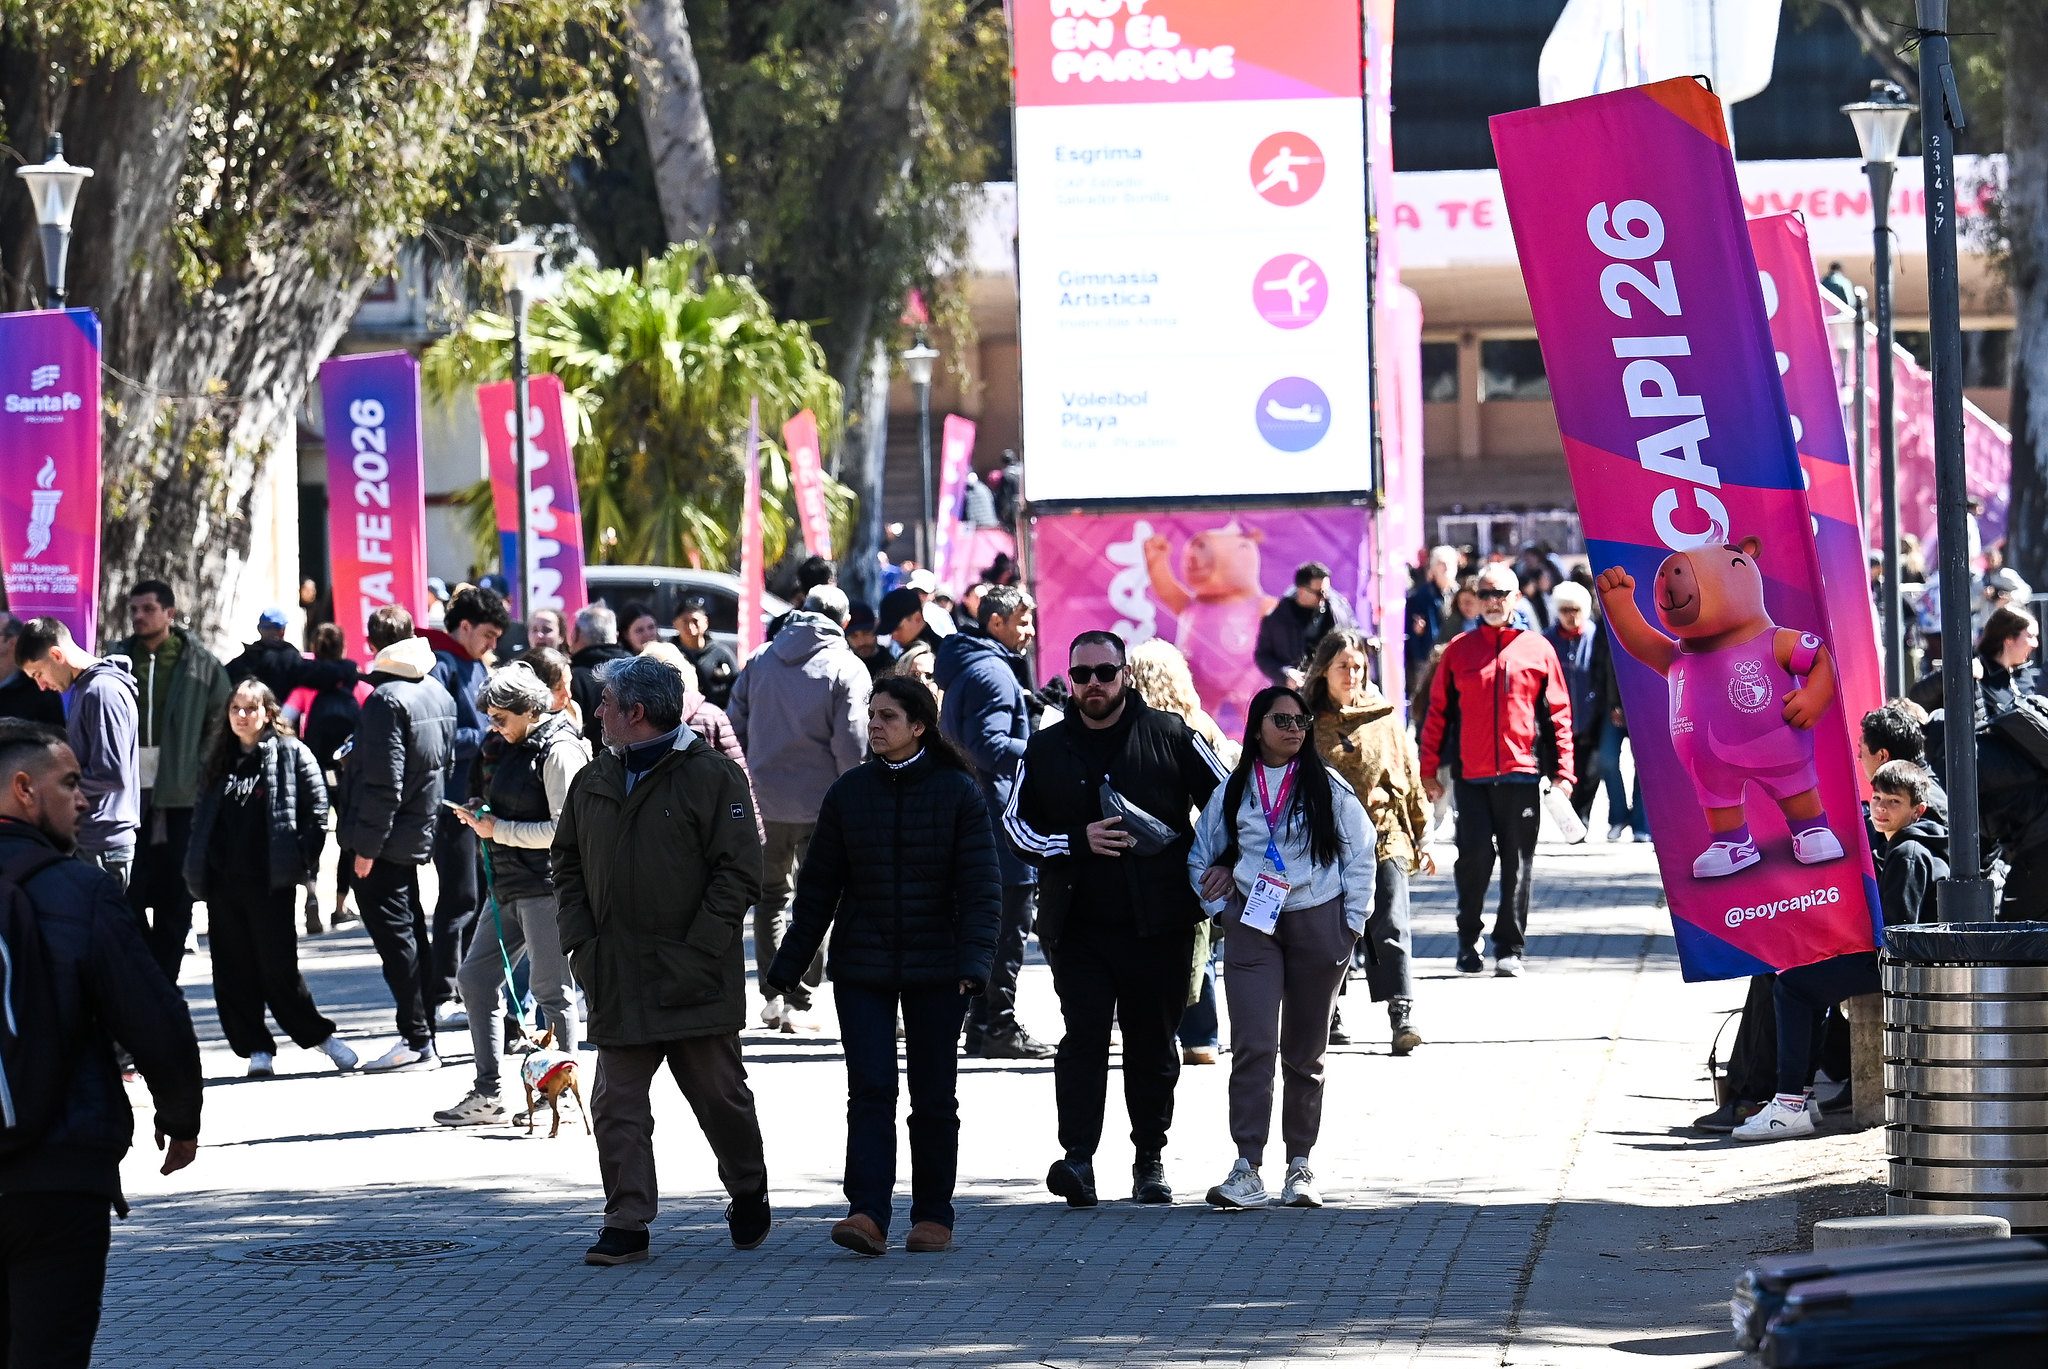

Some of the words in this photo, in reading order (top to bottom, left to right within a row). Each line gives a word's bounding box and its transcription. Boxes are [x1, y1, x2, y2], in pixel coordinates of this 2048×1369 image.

[1051, 17, 1114, 50] EN
[1125, 15, 1181, 49] EL
[1052, 45, 1235, 83] PARQUE
[1055, 145, 1142, 165] Esgrima
[1438, 199, 1493, 229] TE
[1586, 199, 1682, 319] 26
[1058, 269, 1158, 286] Gimnasia
[5, 394, 62, 412] Santa
[62, 392, 81, 411] Fe
[1061, 413, 1118, 431] Playa
[350, 399, 390, 508] 2026
[1611, 335, 1730, 552] CAPI
[356, 511, 393, 564] FE
[1801, 633, 1819, 649] C
[1724, 886, 1840, 928] @soycapi26
